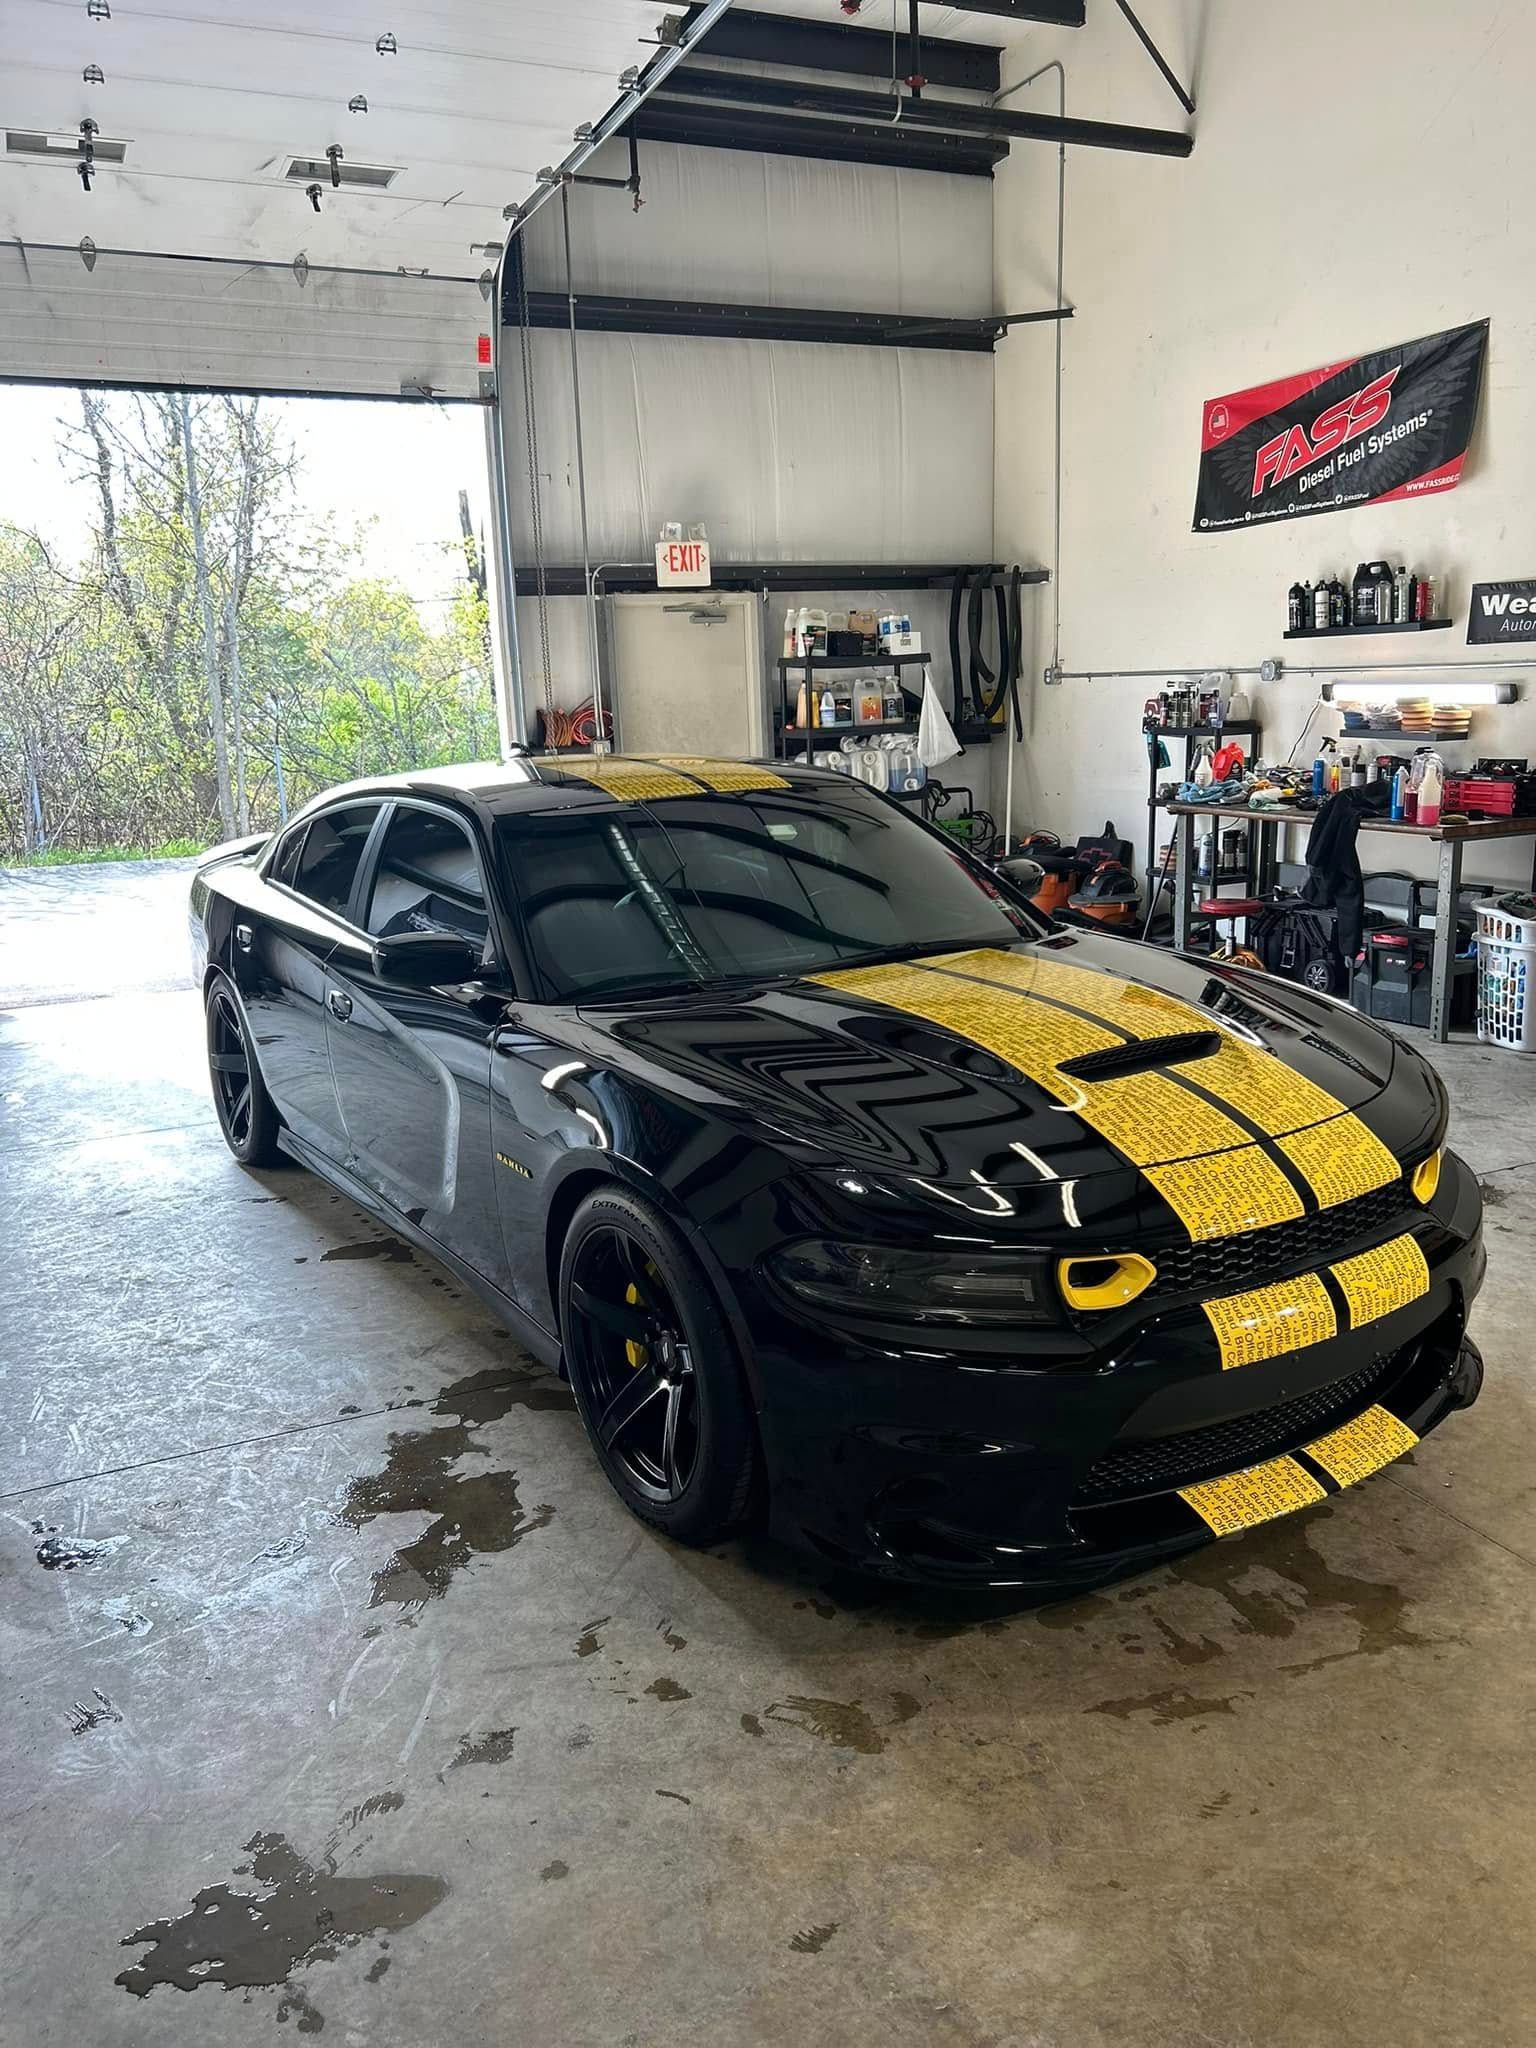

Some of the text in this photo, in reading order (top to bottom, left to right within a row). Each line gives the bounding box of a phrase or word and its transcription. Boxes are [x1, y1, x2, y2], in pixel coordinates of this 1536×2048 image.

[1251, 365, 1401, 497] FASS
[1298, 459, 1334, 494] Diesel
[1337, 442, 1365, 471] Fuel
[668, 544, 701, 572] EXIT
[1481, 593, 1536, 616] Wea
[1104, 1128, 1141, 1157] Operator
[1154, 1177, 1193, 1218] Anderson
[1192, 1224, 1205, 1239] To
[1160, 1170, 1198, 1209] Operator
[1178, 1162, 1217, 1206] Firefighter
[1185, 1184, 1210, 1209] Chief
[1207, 1169, 1242, 1208] Operator
[1219, 1171, 1246, 1200] Hayes
[1223, 1162, 1242, 1180] Tow
[1238, 1180, 1269, 1222] Operator
[1241, 1159, 1259, 1175] Tow
[1254, 1175, 1287, 1216] Operator
[1249, 1156, 1277, 1184] Officer
[1274, 1187, 1295, 1215] David
[1208, 1303, 1231, 1347] Zachary
[1218, 1300, 1238, 1329] Chad
[1263, 1286, 1292, 1344] Chrisopher
[1319, 1293, 1335, 1327] Daniel
[1221, 1489, 1245, 1510] Luke
